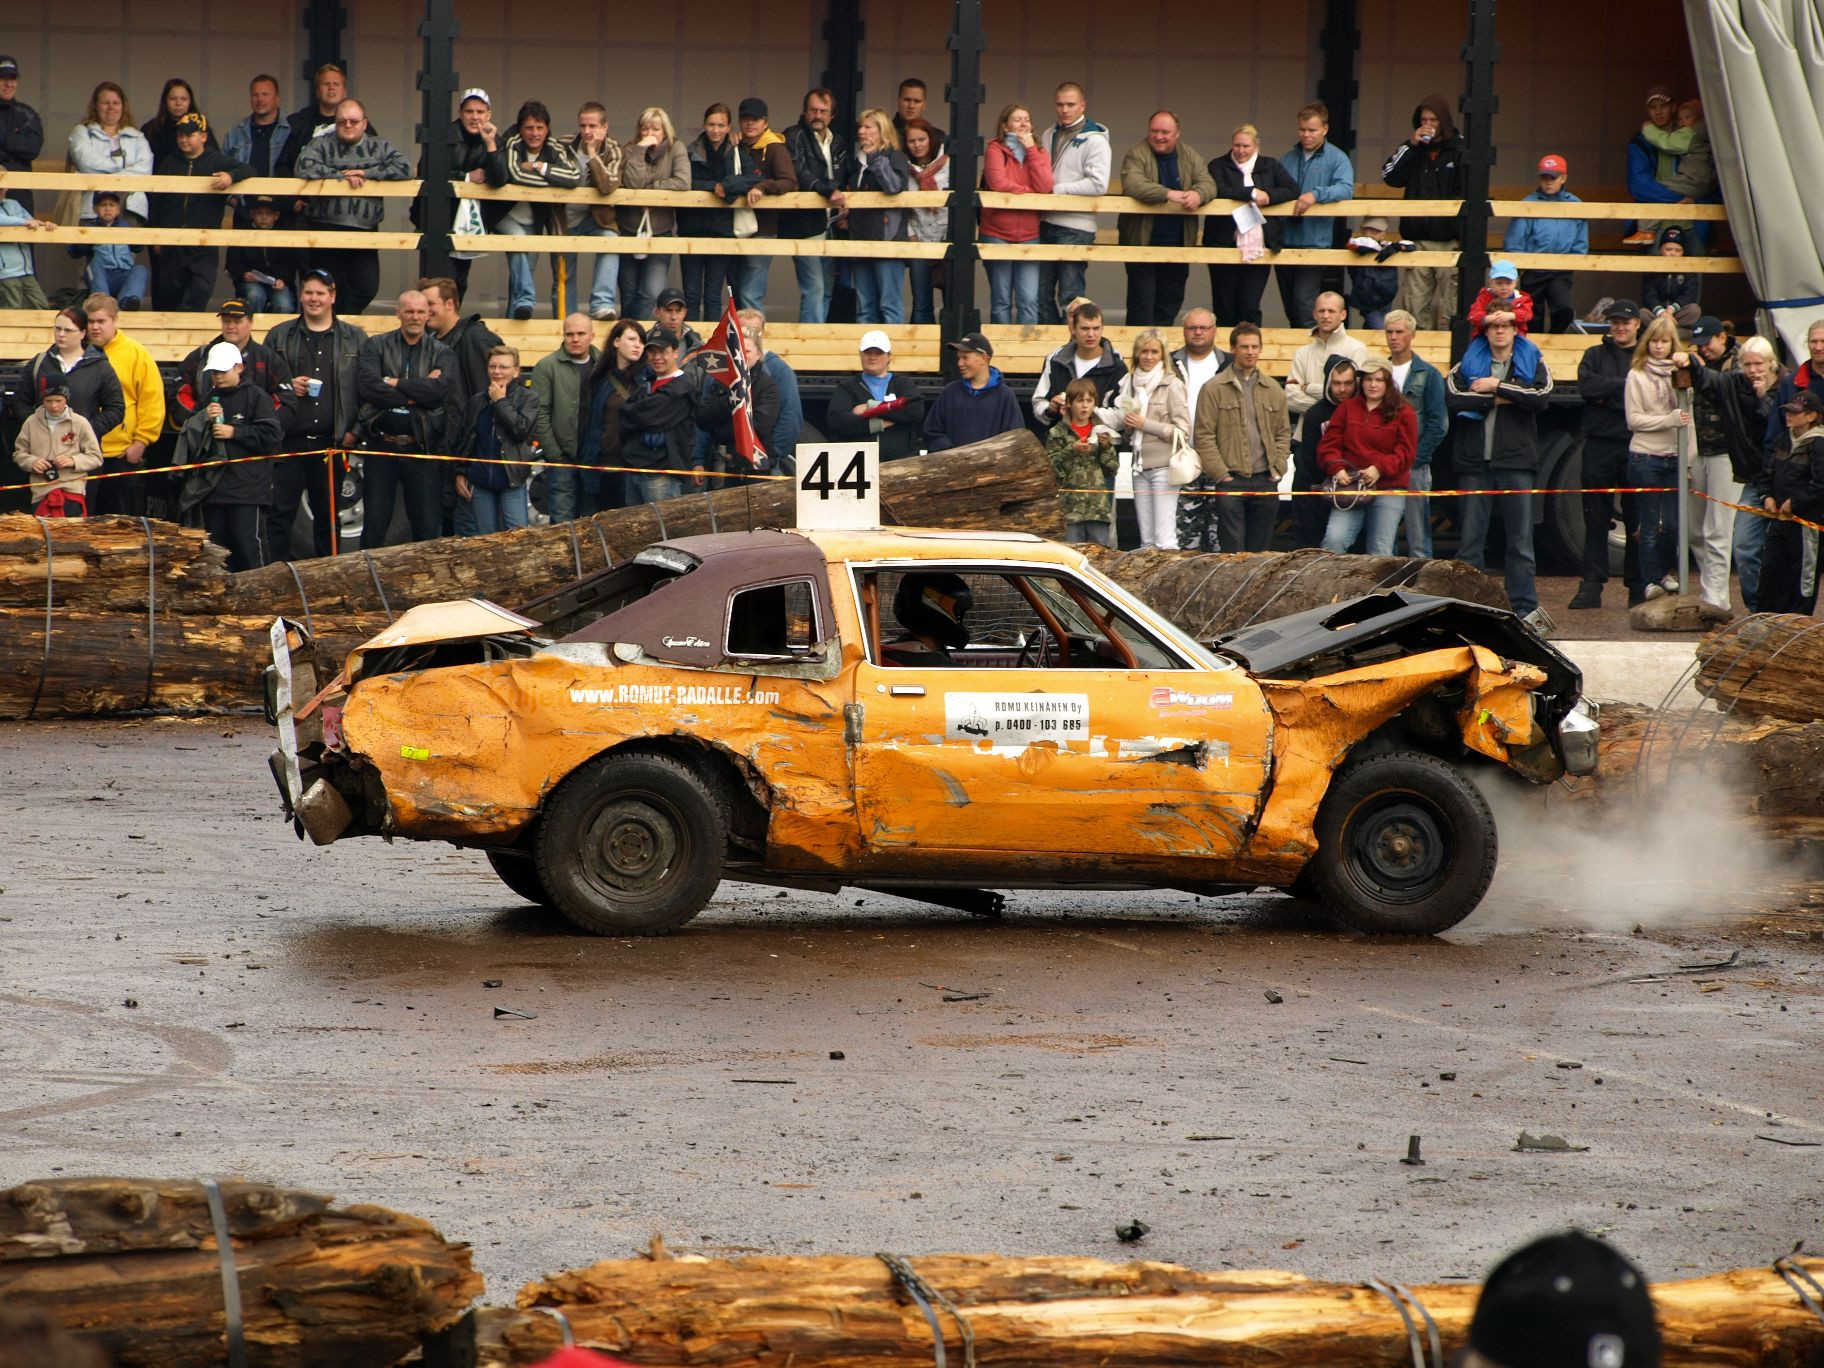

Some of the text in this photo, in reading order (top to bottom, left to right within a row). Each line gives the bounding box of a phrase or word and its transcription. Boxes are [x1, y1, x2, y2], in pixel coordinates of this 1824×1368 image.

[801, 450, 871, 500] 44
[995, 701, 1021, 712] ROMU
[995, 721, 1004, 732] p.
[1006, 719, 1032, 731] 0400
[1040, 719, 1057, 731] 103
[1062, 719, 1081, 731] 685
